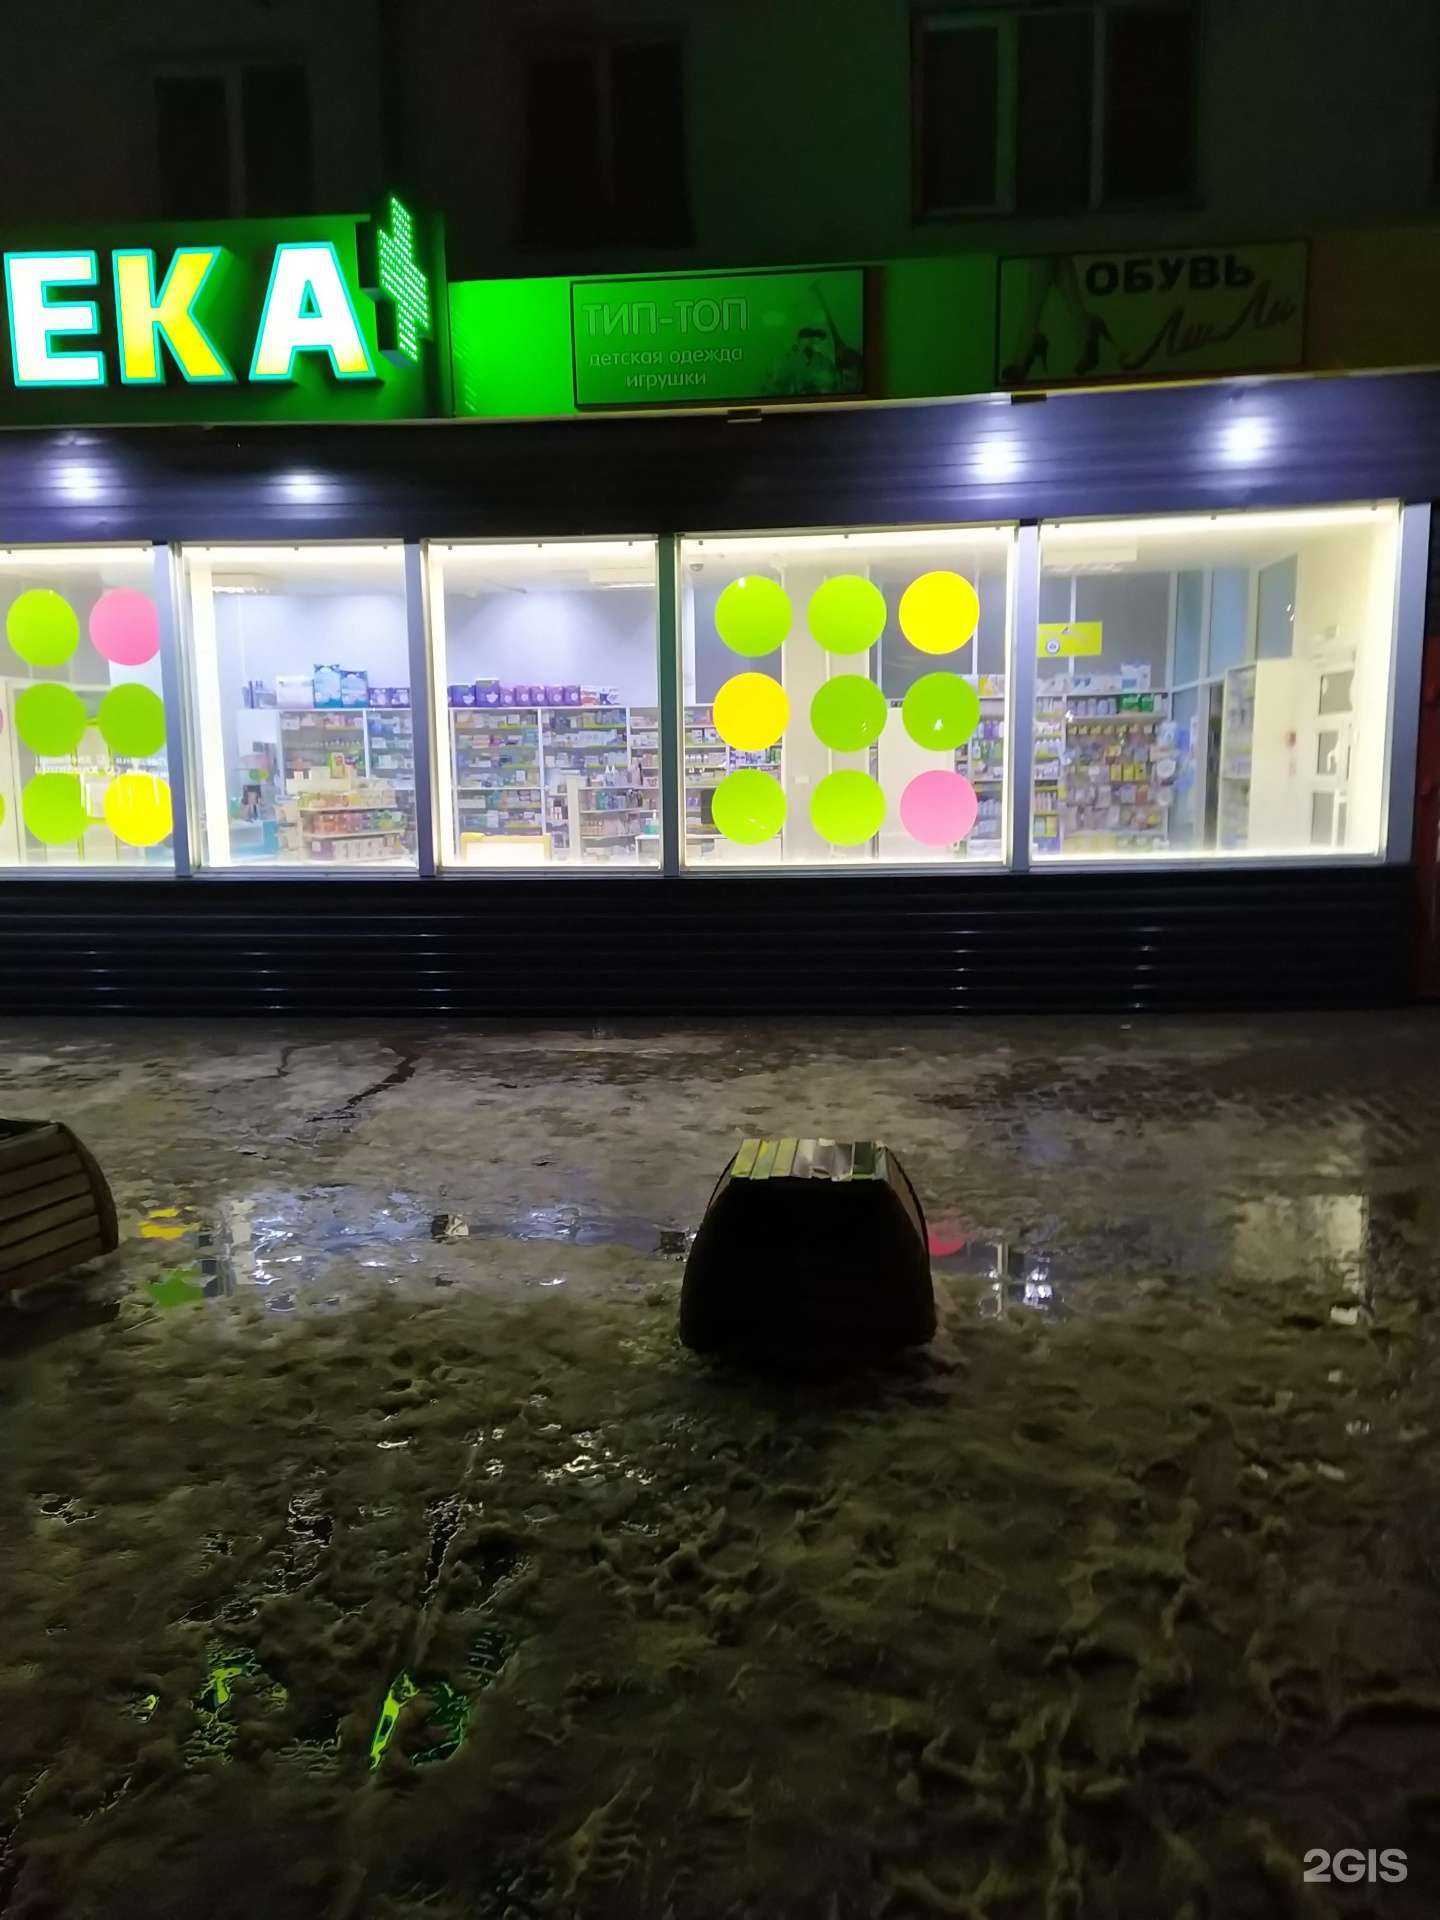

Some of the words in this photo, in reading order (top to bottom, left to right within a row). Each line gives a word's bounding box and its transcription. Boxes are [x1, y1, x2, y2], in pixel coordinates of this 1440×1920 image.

[1086, 254, 1256, 295] ОБУВЬ
[4, 241, 377, 387] ЕКА
[581, 297, 749, 336] ТИП-ТОП
[589, 350, 664, 367] детская
[669, 346, 743, 365] одежда
[624, 372, 706, 391] игрушки
